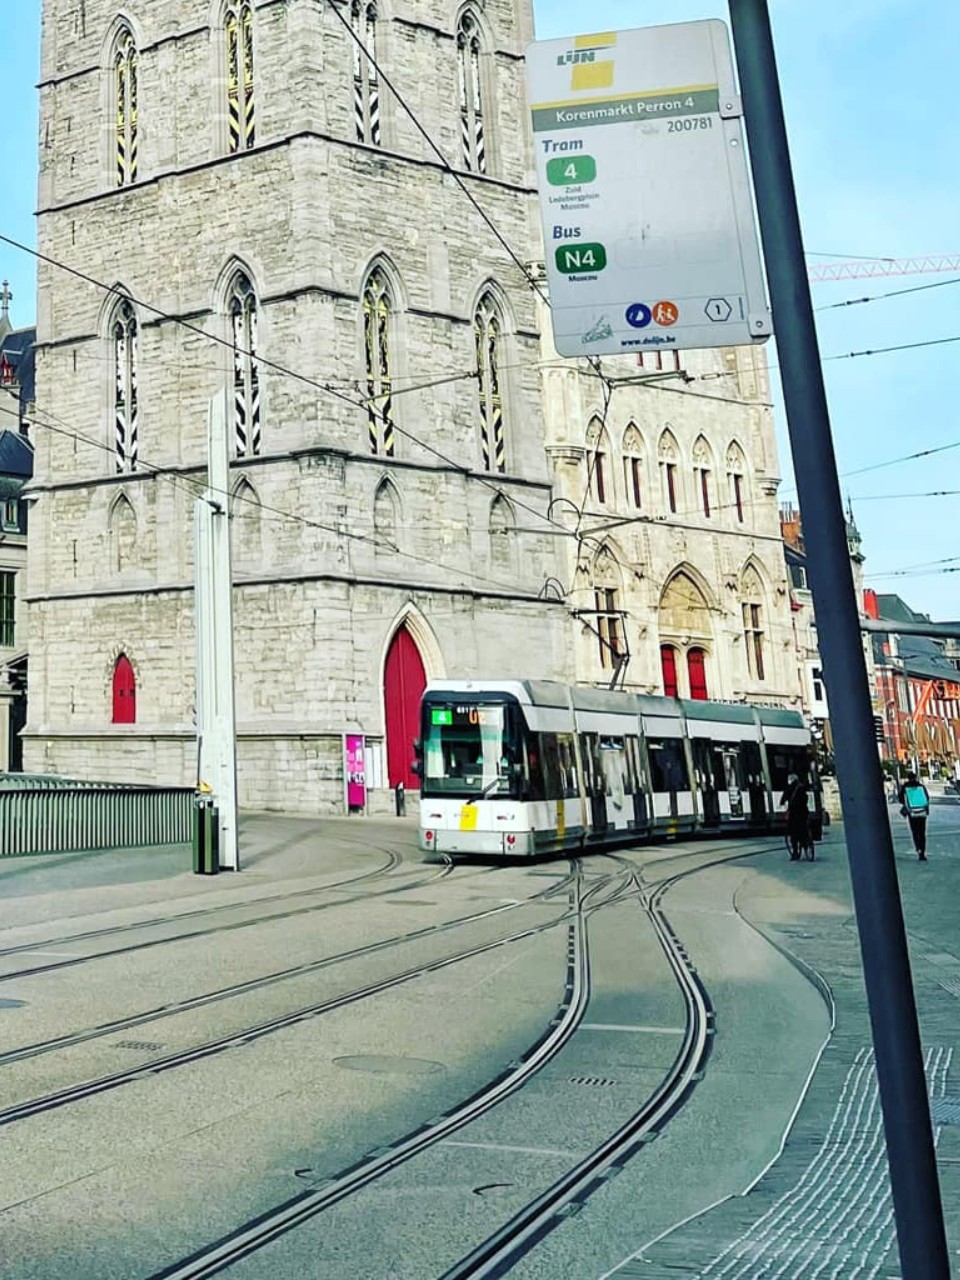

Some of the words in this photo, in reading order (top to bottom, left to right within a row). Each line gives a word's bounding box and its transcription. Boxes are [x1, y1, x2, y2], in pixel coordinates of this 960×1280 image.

[555, 104, 634, 122] Korenmarkt
[637, 99, 682, 114] Perron
[686, 96, 695, 108] 4
[667, 117, 713, 133] 200781
[542, 139, 584, 153] Tram
[564, 163, 578, 179] 4
[552, 225, 581, 239] Bus
[564, 250, 596, 269] N4
